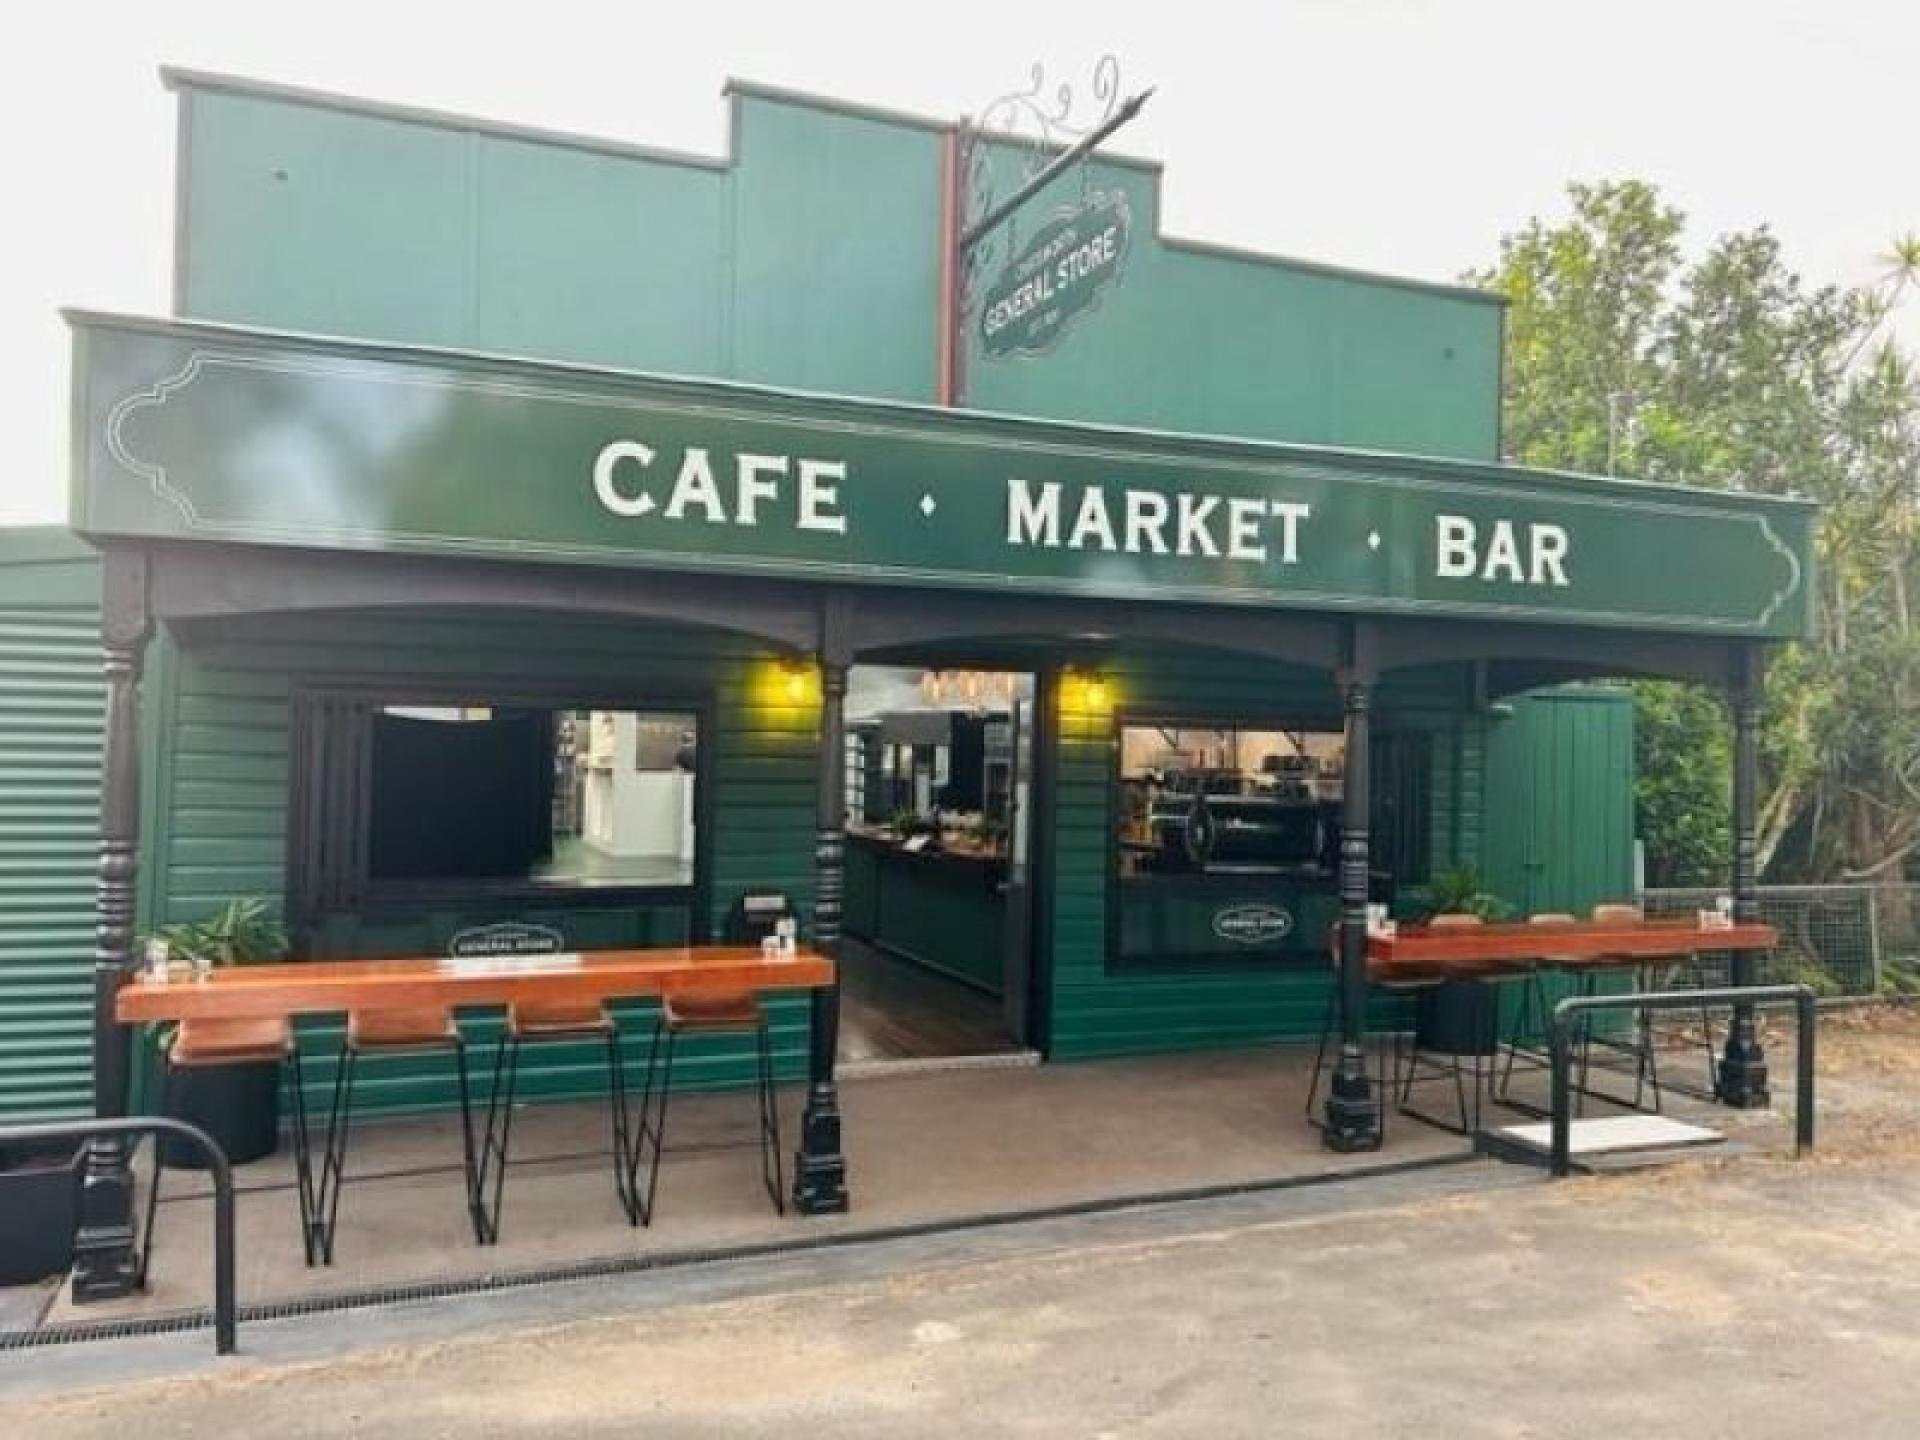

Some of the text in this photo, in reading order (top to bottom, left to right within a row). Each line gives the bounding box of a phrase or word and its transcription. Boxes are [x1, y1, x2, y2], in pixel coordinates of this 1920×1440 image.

[984, 266, 1055, 337] GENERAL
[1057, 226, 1117, 289] STORE
[594, 441, 1569, 586] CAFE MARKET BAR
